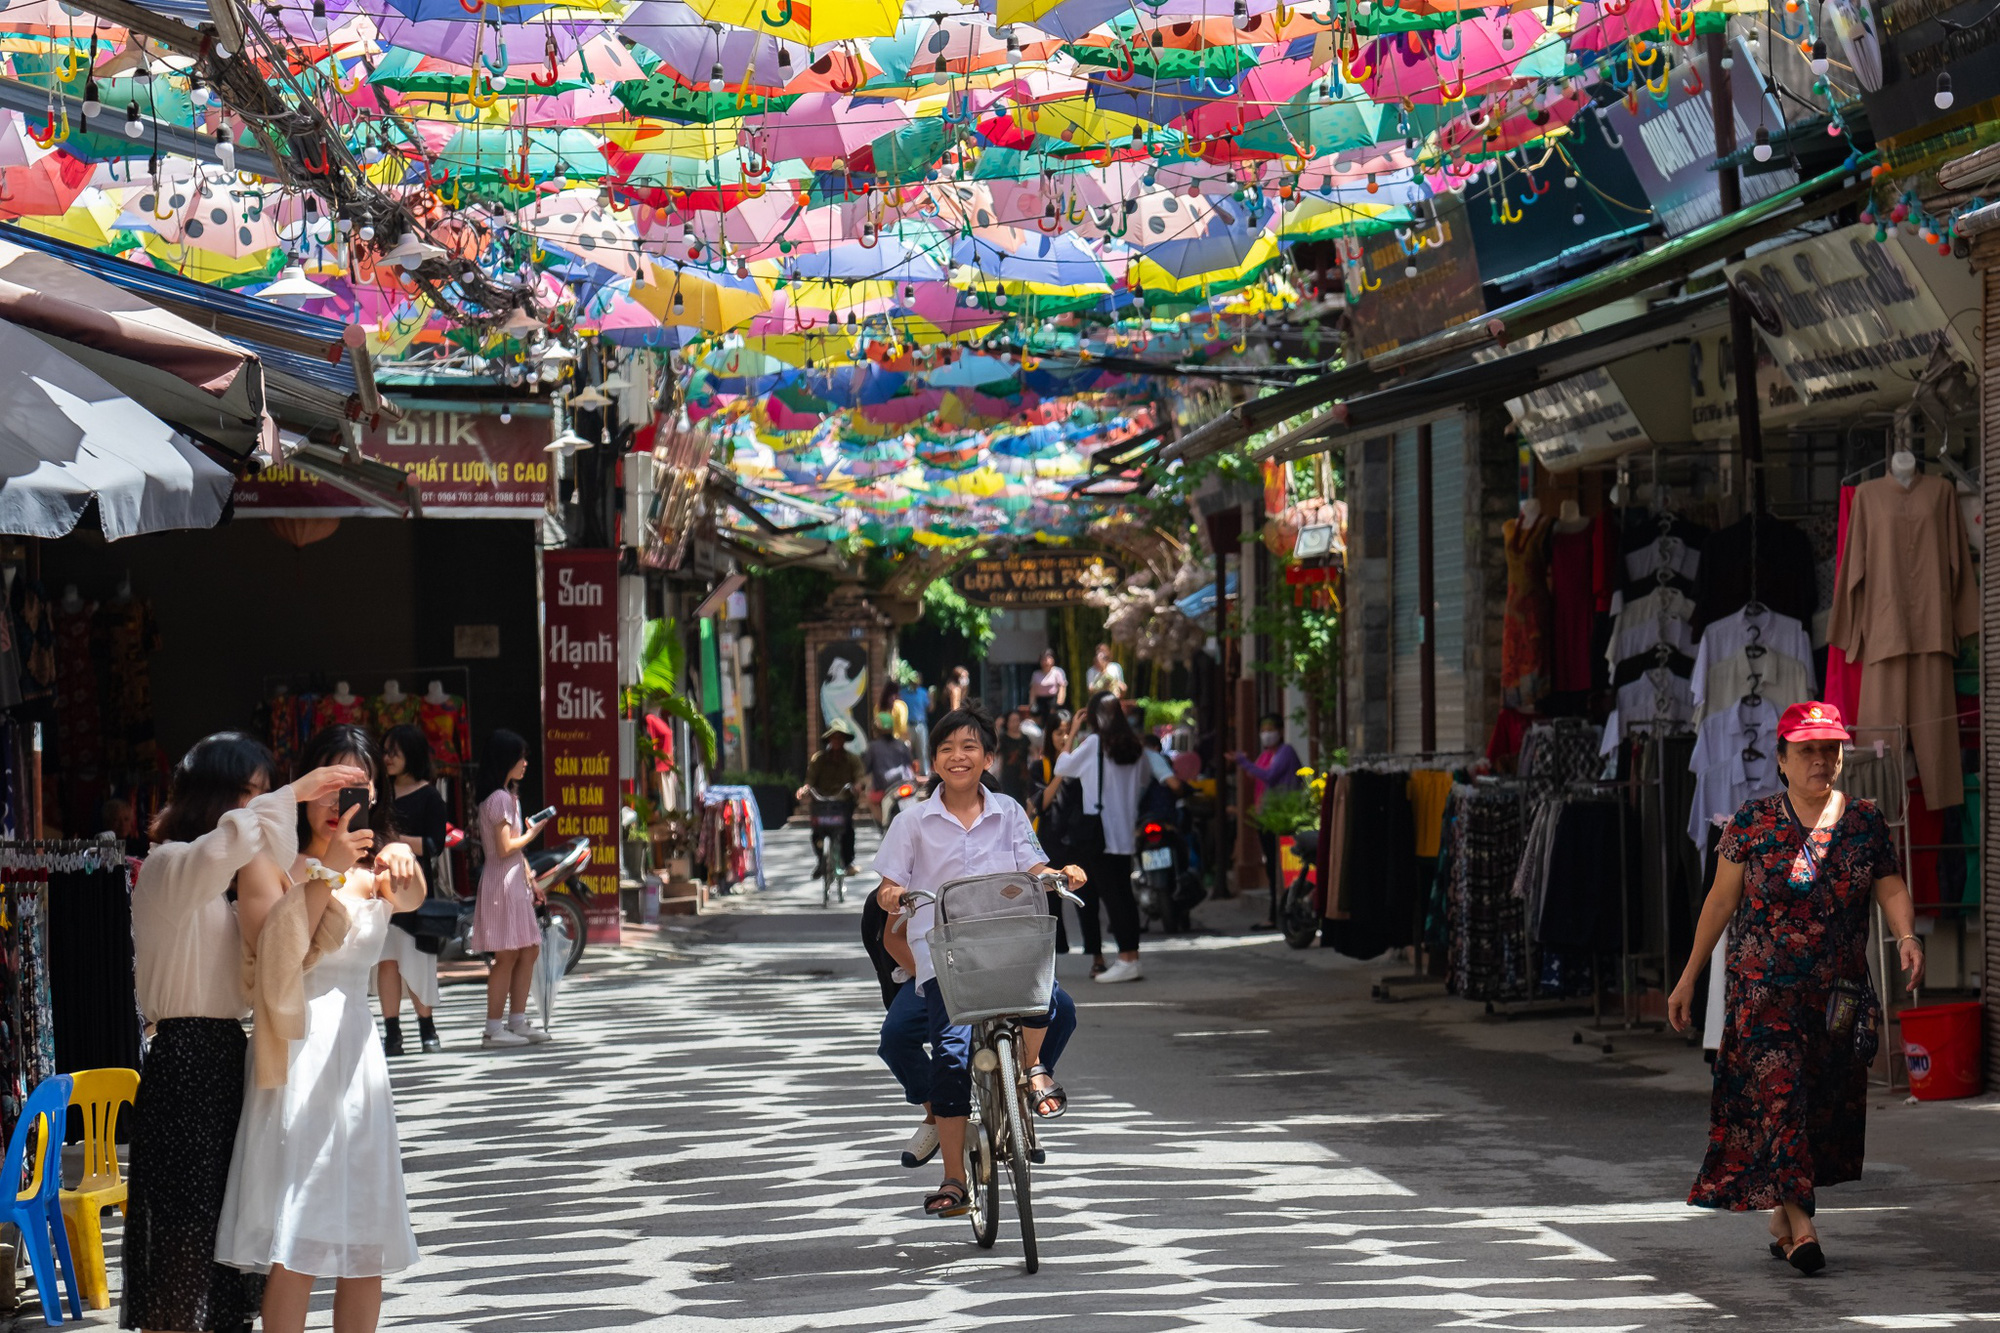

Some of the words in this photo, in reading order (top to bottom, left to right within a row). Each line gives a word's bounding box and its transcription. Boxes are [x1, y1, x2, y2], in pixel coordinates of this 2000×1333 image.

[1638, 109, 1698, 182] QUANG
[513, 462, 548, 483] CAO
[558, 568, 603, 606] Sơn
[549, 625, 613, 670] Hạnh
[557, 682, 606, 719] Silk
[554, 749, 578, 776] SẢN
[580, 750, 610, 776] XUẤT
[561, 782, 577, 806] VÀ
[579, 782, 604, 806] BÁN
[557, 812, 580, 836] CÁC
[600, 875, 617, 894] CAO
